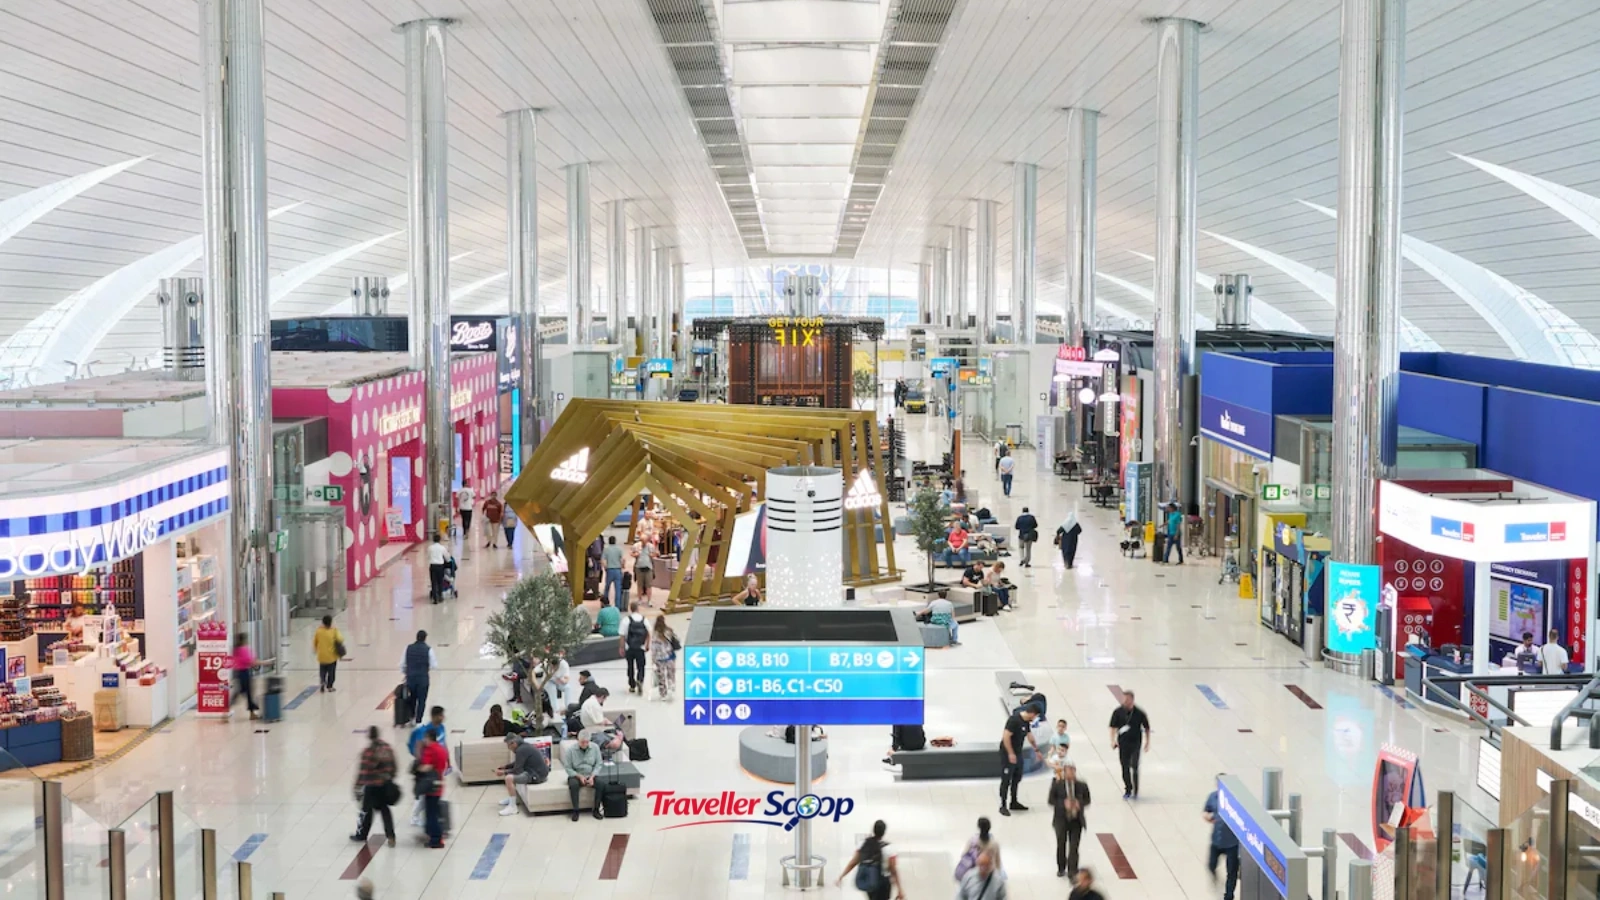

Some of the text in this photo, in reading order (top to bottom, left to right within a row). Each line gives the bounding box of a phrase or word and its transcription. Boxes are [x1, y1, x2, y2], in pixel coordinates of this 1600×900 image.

[768, 316, 825, 328] GET YOUR
[450, 321, 493, 346] Boots
[550, 468, 588, 484] adidas
[844, 494, 882, 510] adidas
[100, 515, 157, 562] Works
[762, 652, 789, 666] B10
[853, 653, 874, 667] B9
[202, 699, 225, 707] FREE
